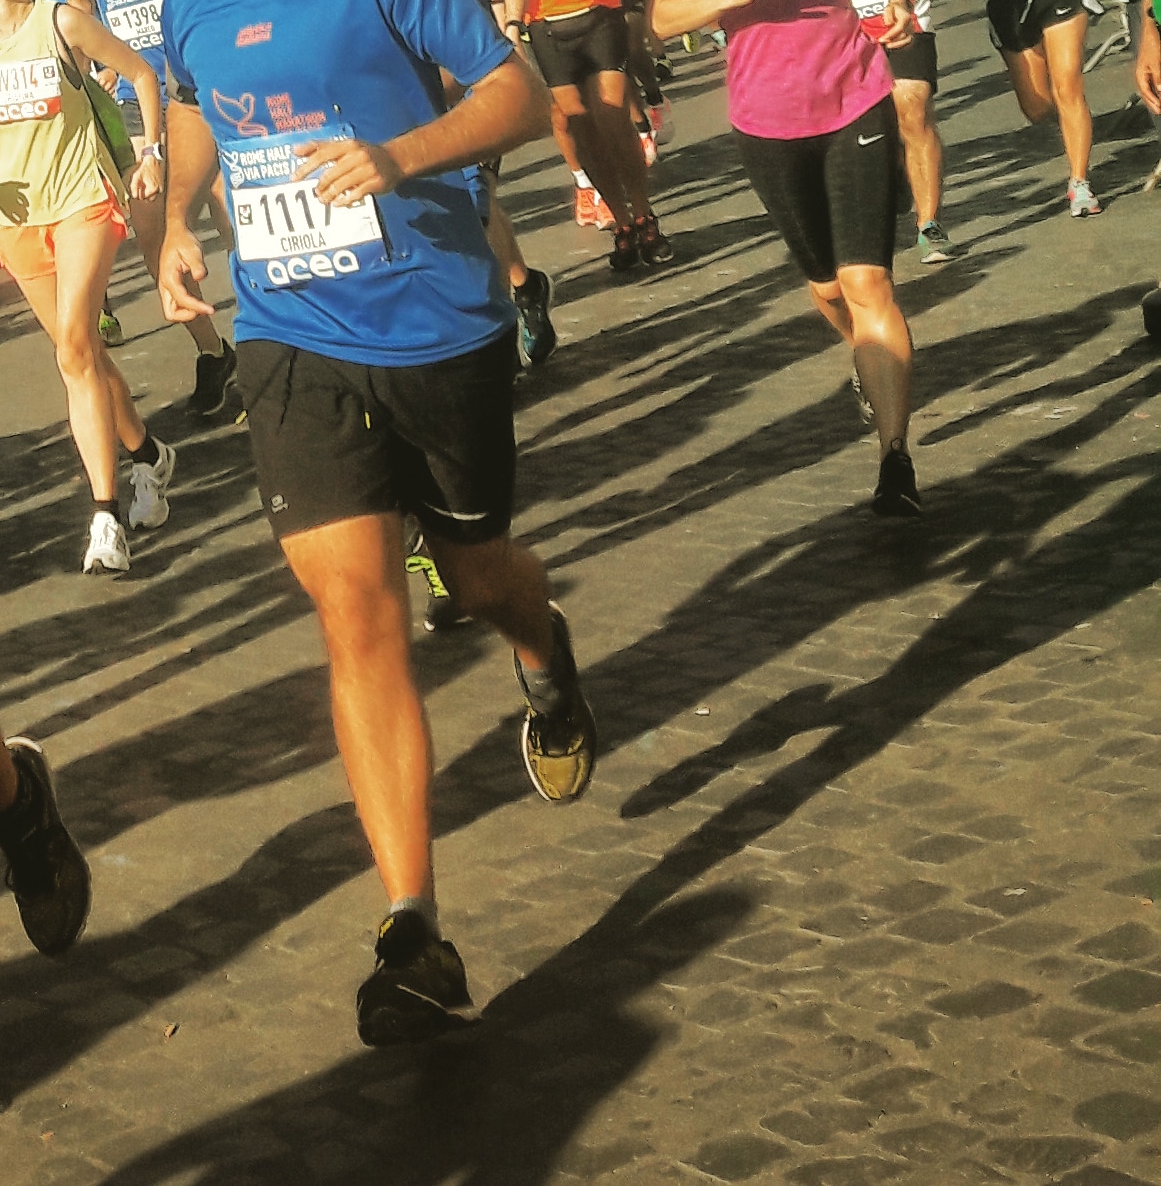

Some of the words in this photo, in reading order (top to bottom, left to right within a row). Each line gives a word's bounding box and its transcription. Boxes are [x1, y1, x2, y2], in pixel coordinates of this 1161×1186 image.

[123, 4, 160, 29] 1398
[129, 33, 164, 51] ace
[239, 149, 267, 166] ROME
[244, 166, 261, 181] VIA
[262, 160, 290, 179] PACIS
[280, 232, 327, 253] CIRIOLA
[266, 249, 360, 286] acea
